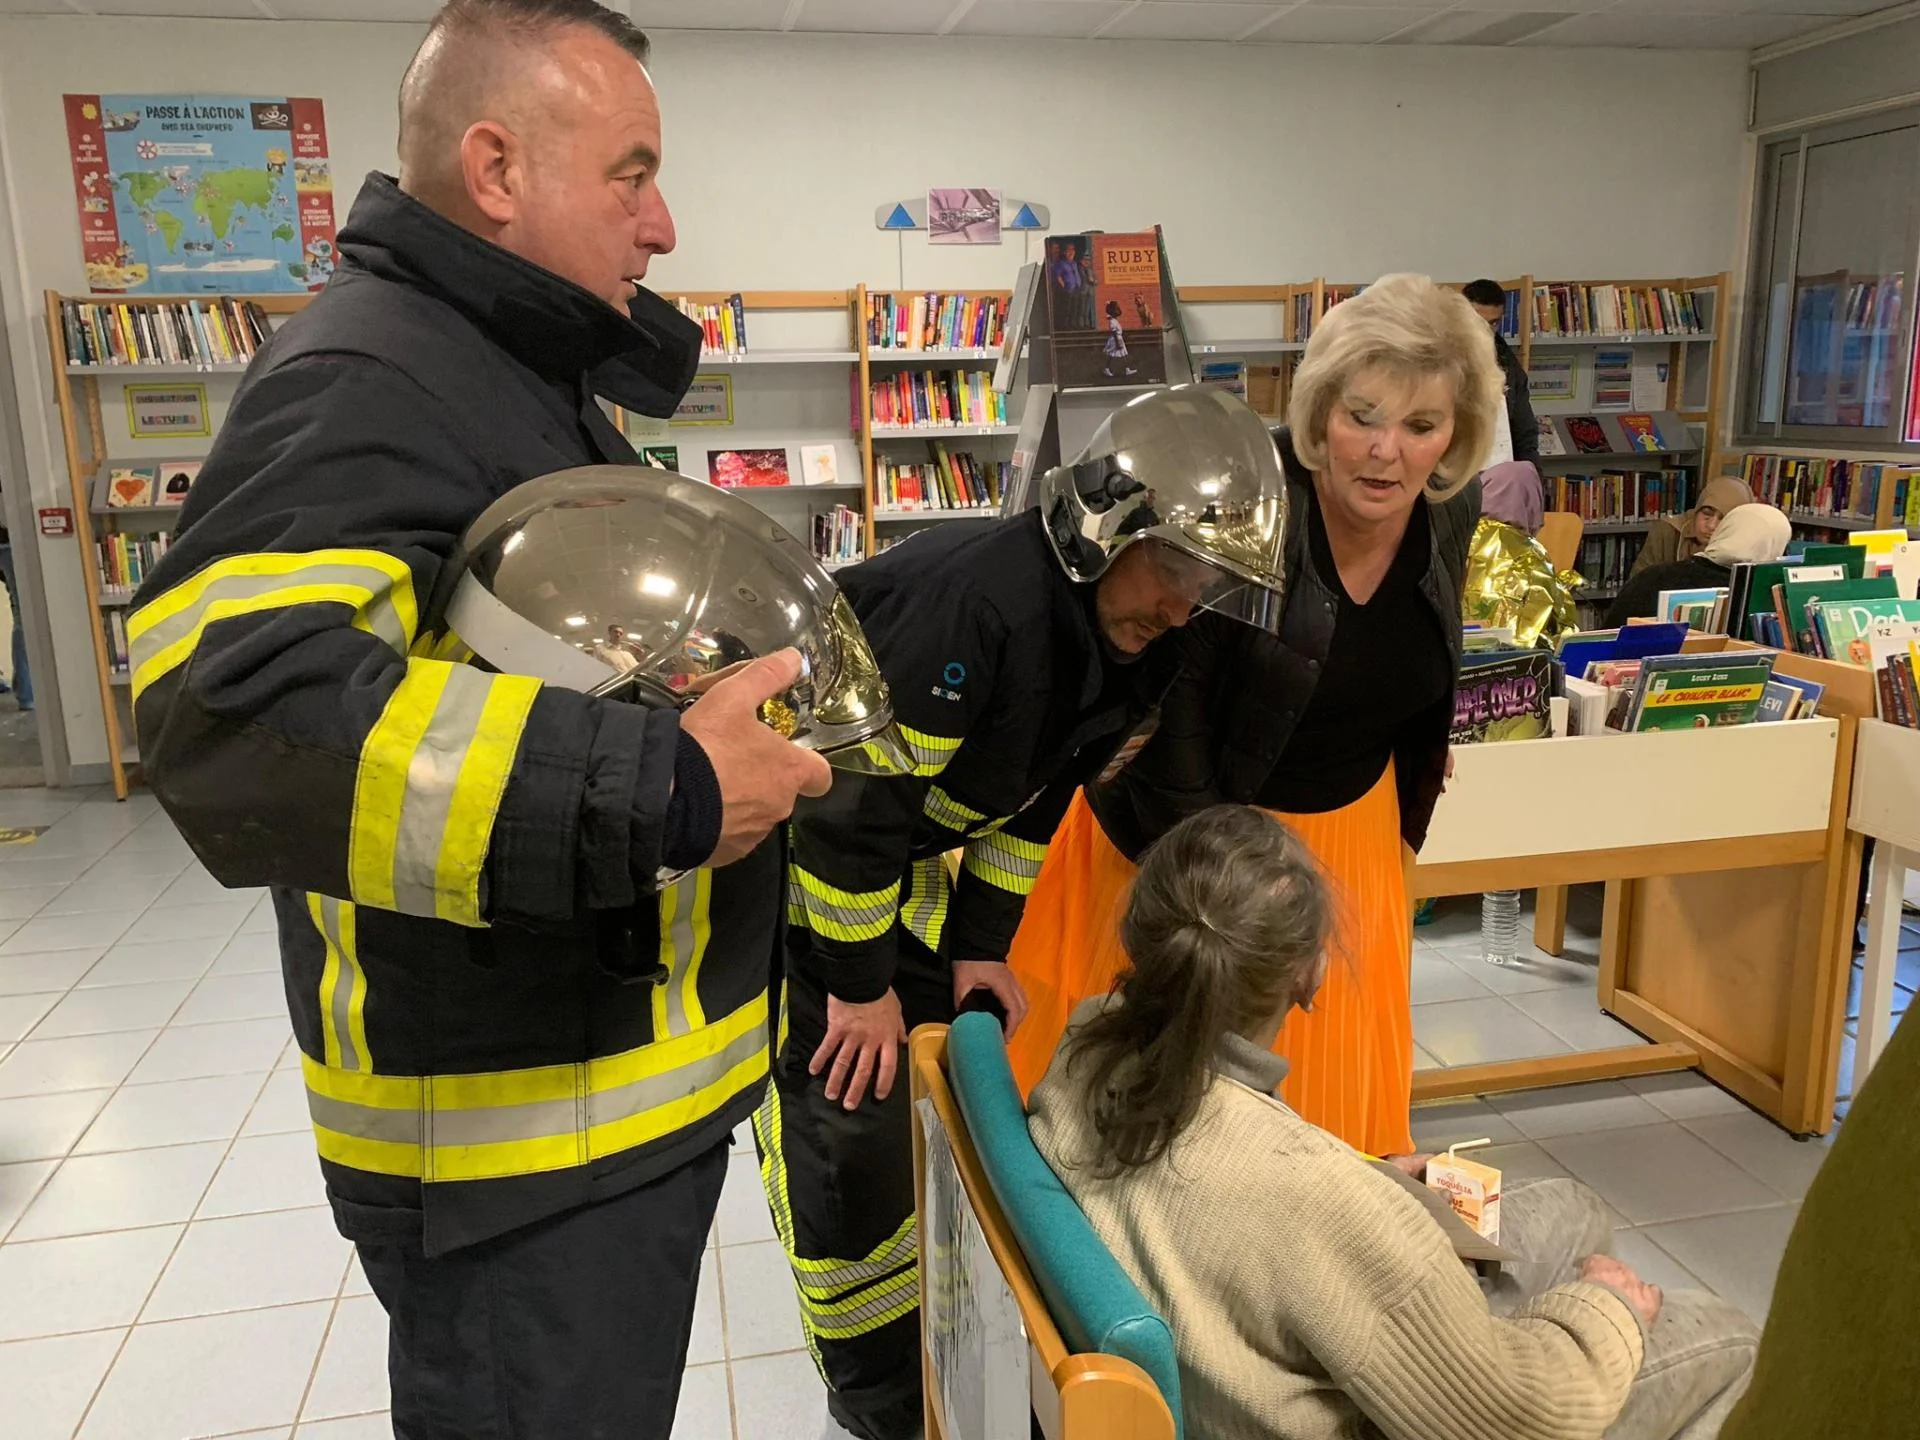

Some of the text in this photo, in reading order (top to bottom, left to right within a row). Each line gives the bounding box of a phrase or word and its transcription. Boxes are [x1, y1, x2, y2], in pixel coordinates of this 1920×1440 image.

[146, 103, 245, 119] PASSE À L'ACTION
[1107, 250, 1155, 263] RUBY
[1792, 568, 1840, 580] N N
[1877, 628, 1892, 637] Y-Z
[1452, 675, 1538, 728] AME OVER
[1656, 694, 1671, 704] LE
[1452, 1198, 1464, 1208] US
